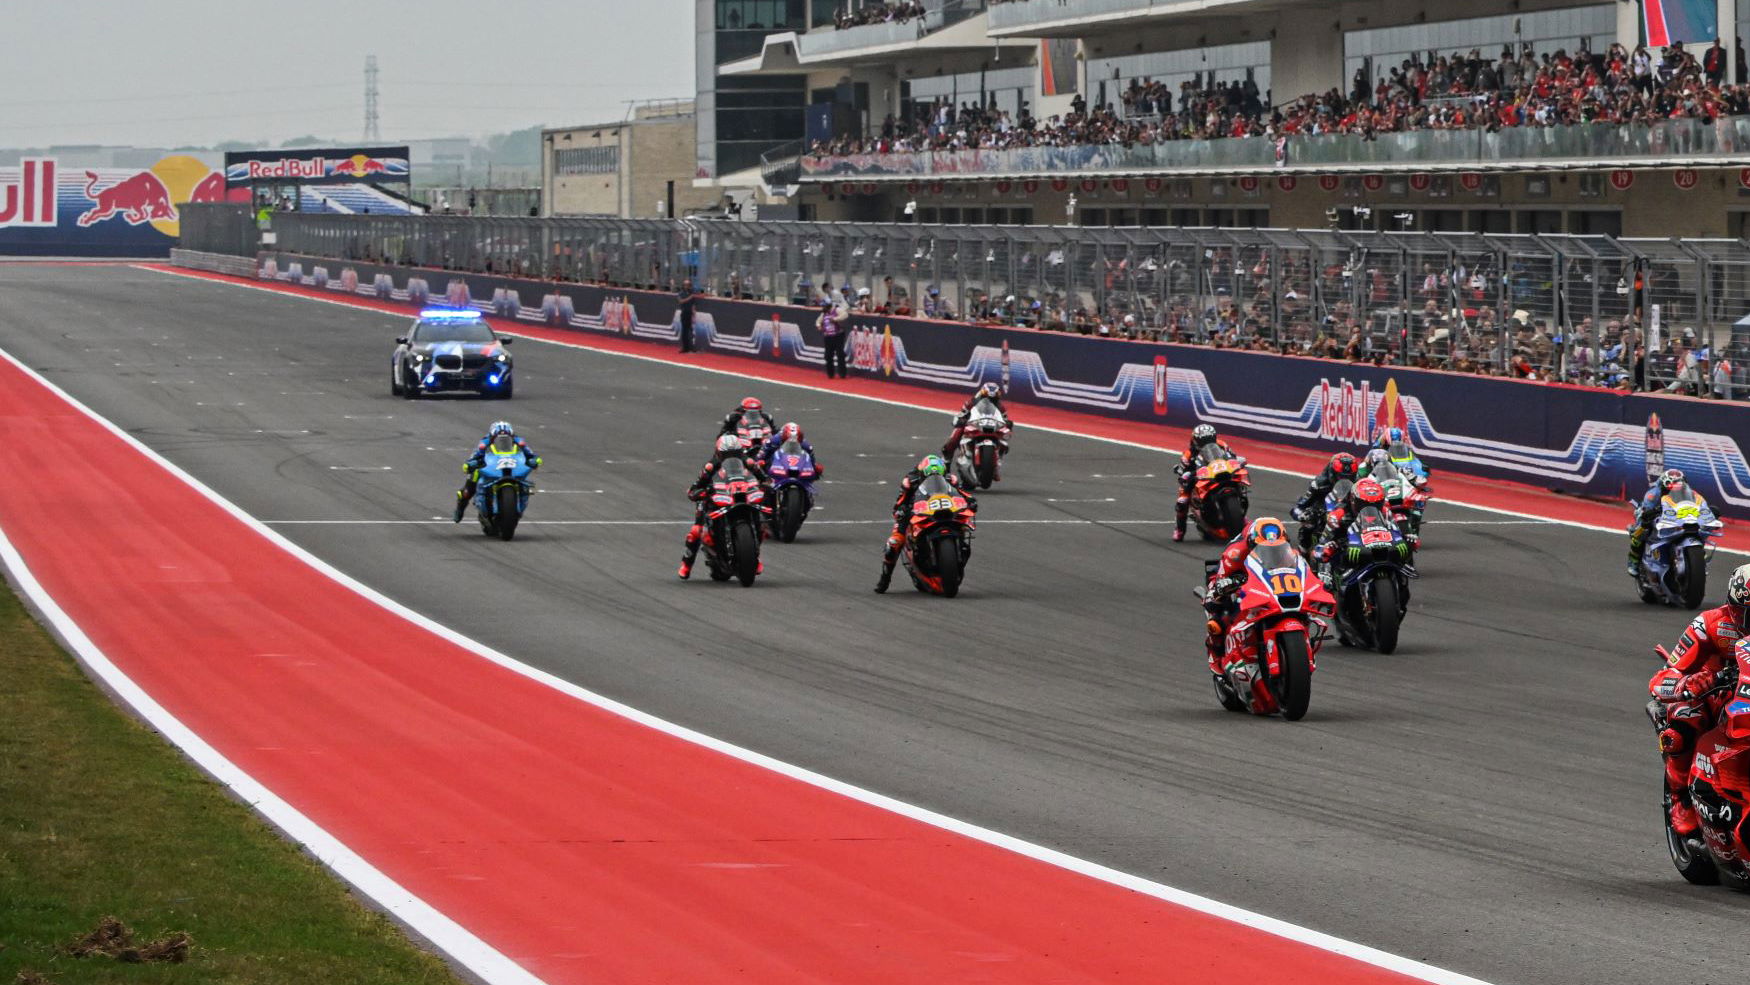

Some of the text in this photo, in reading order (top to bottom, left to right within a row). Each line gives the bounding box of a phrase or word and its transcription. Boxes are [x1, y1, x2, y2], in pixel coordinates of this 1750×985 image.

[249, 158, 324, 178] Red Bull
[1618, 172, 1627, 184] 19
[1680, 171, 1692, 184] 20
[1321, 380, 1369, 442] Red Bull
[928, 497, 953, 511] 33
[1271, 575, 1300, 595] 10
